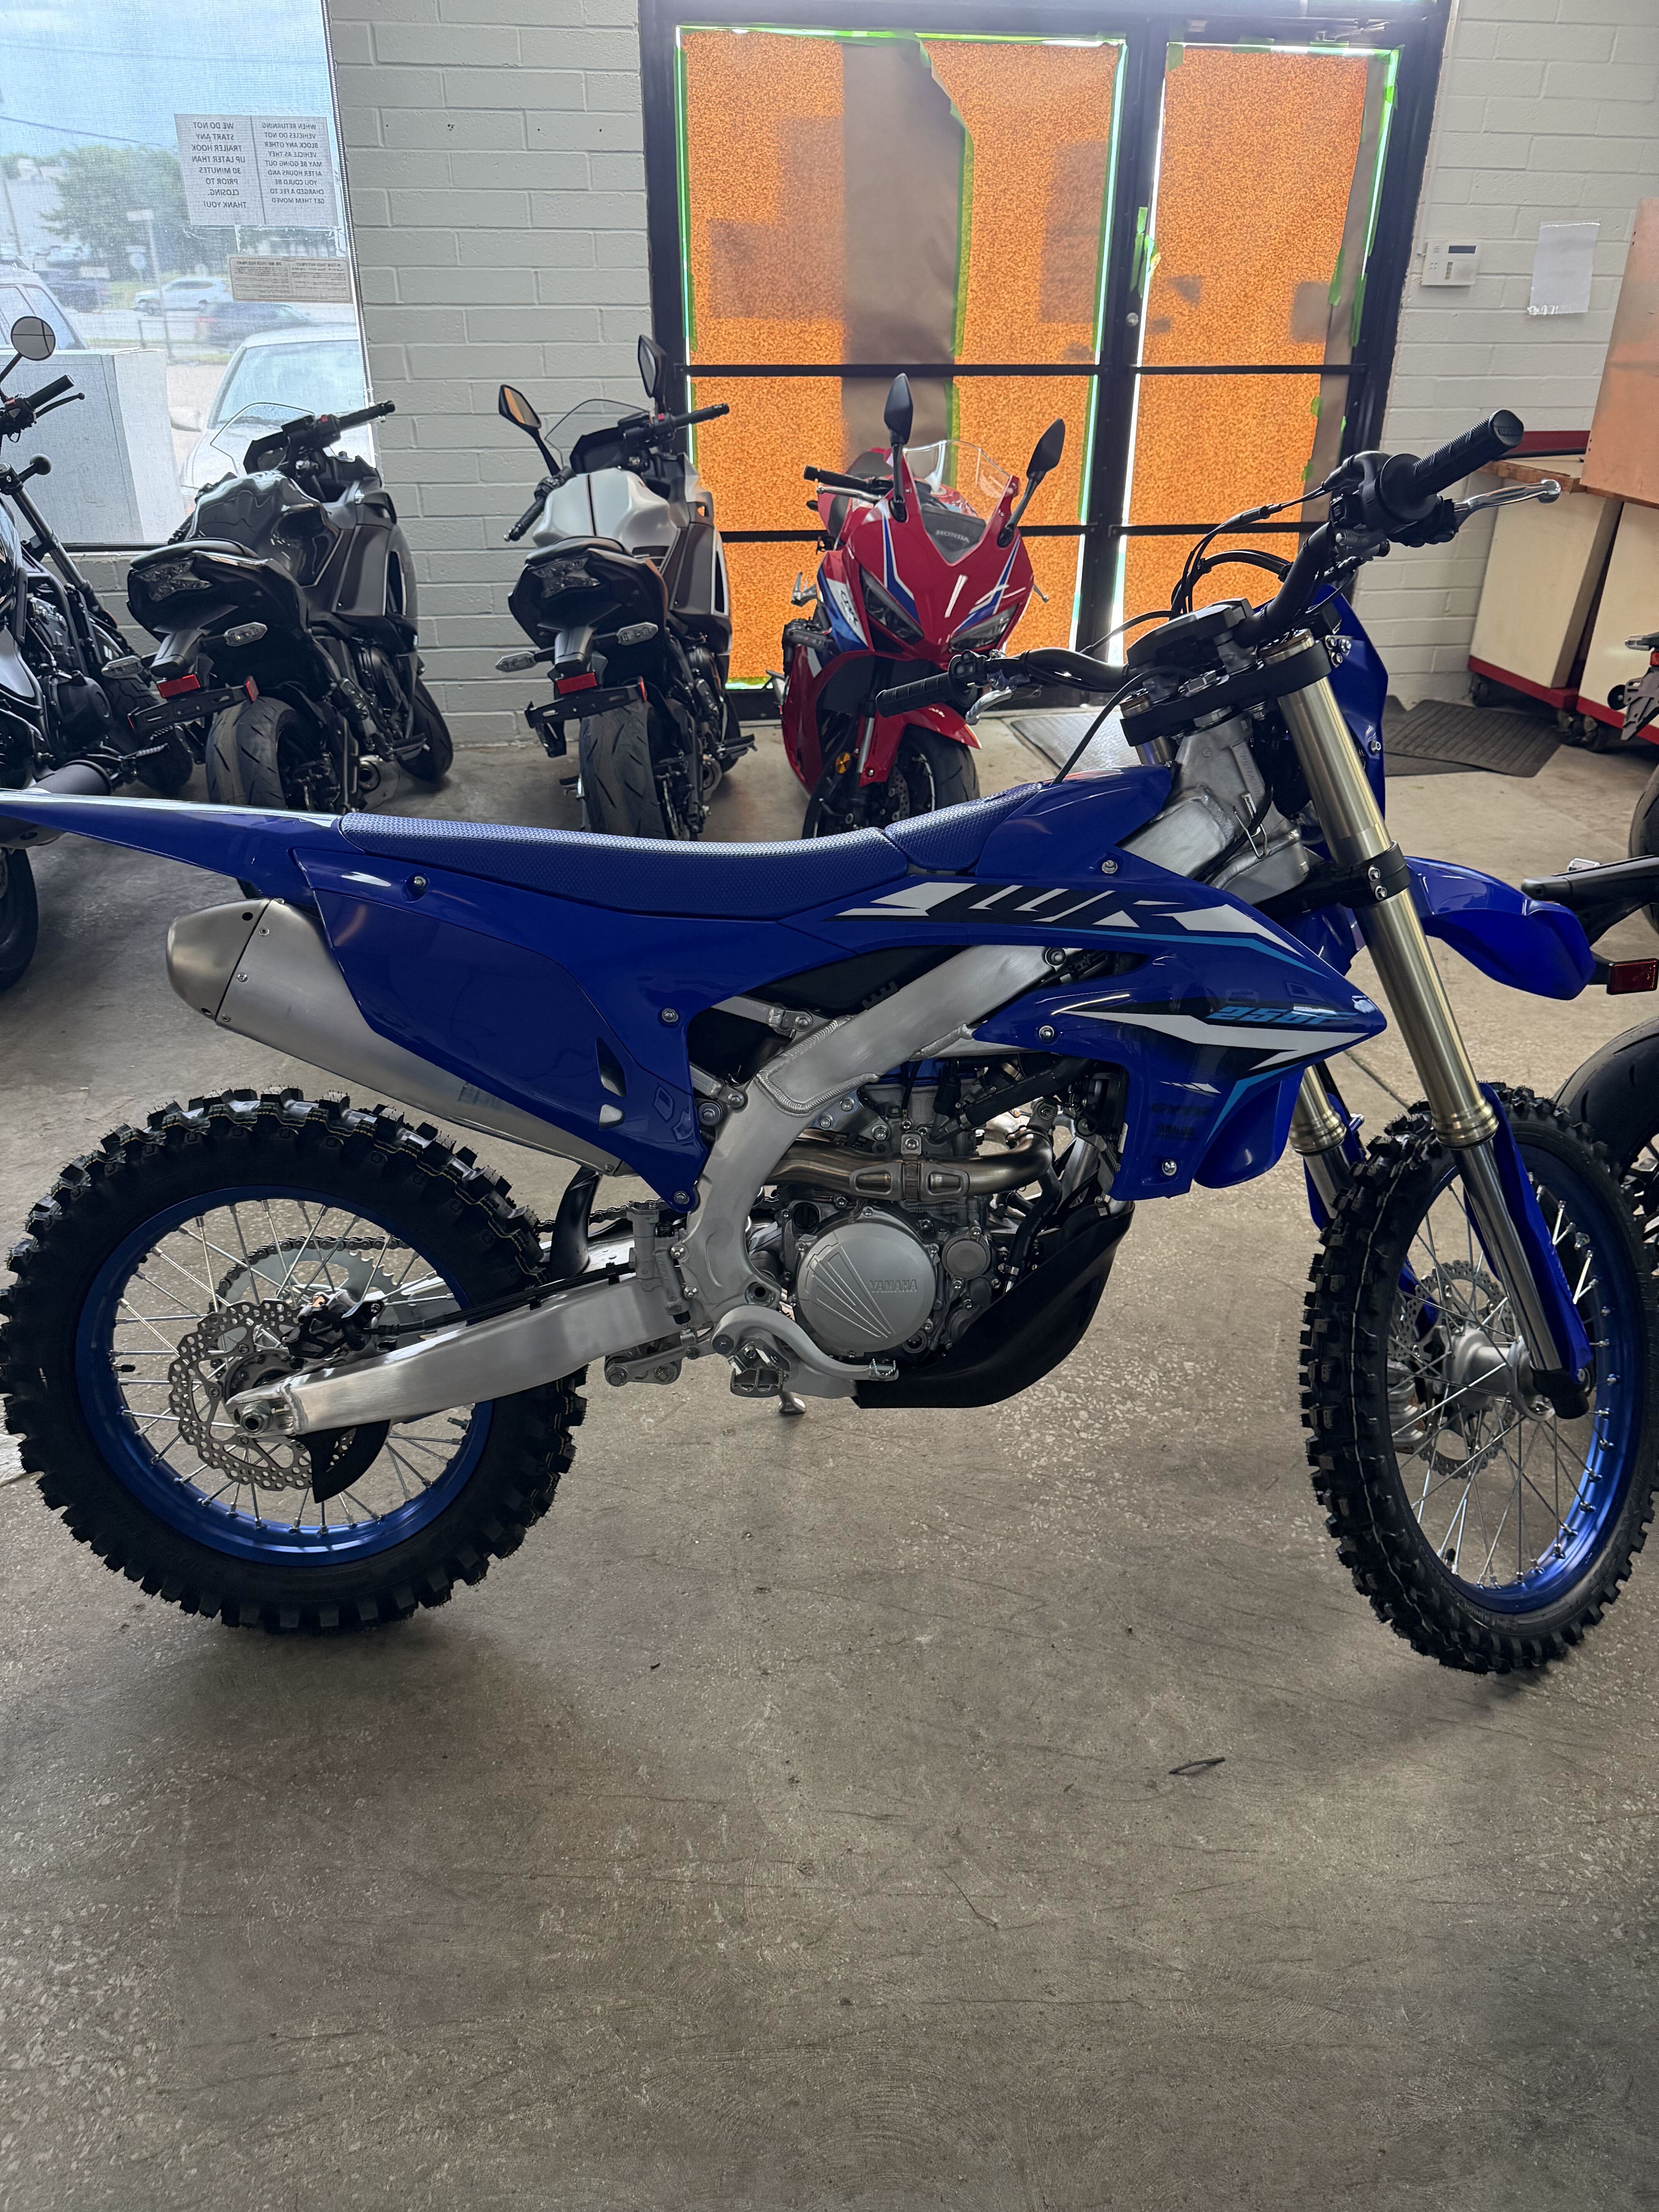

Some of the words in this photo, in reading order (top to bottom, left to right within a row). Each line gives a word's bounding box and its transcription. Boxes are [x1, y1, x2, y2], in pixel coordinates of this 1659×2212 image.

[936, 529, 970, 543] HONDA
[1205, 1006, 1358, 1025] 250F
[868, 1279, 917, 1293] YAMAHA
